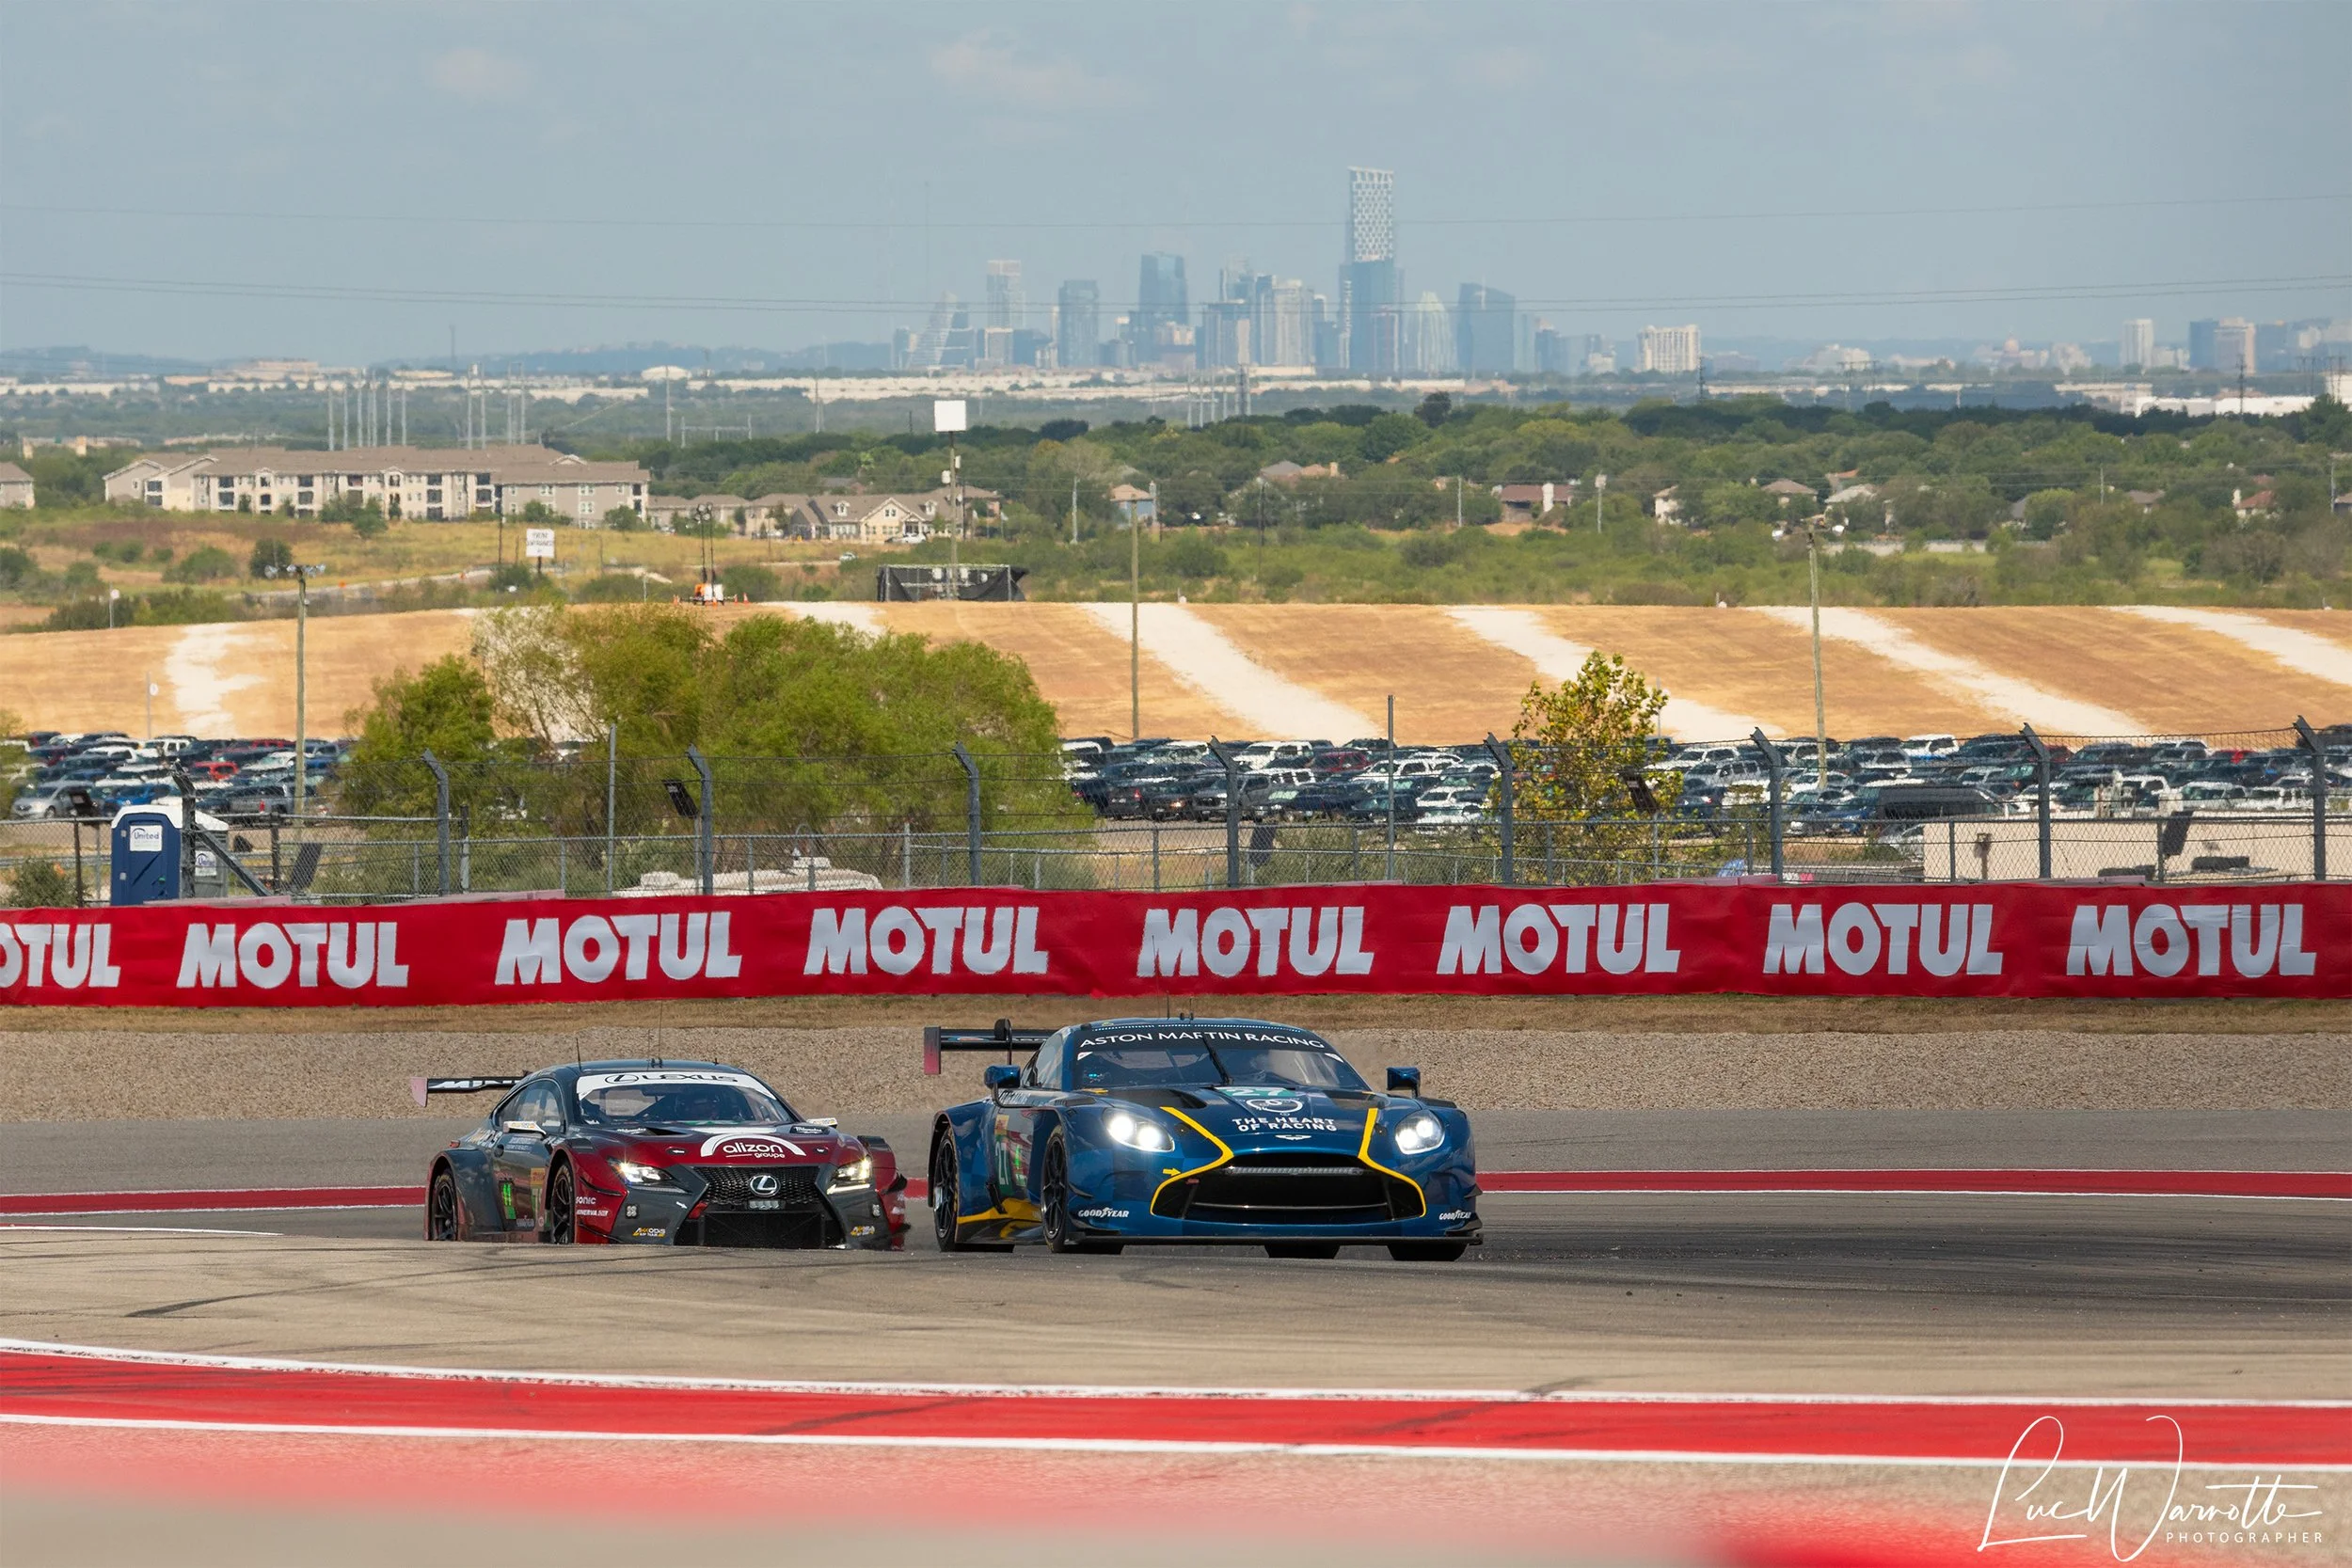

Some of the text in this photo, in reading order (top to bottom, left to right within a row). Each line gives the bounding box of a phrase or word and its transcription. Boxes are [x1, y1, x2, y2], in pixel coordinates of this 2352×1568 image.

[176, 922, 408, 989] MOTUL
[495, 911, 741, 985] MOTUL
[803, 907, 1048, 975] MOTUL
[1136, 906, 1374, 977] MOTUL
[1437, 903, 1681, 974] MOTUL
[1762, 902, 2003, 976] MOTUL
[2066, 904, 2316, 978] MOTUL
[1080, 1031, 1325, 1049] ASTON MARTIN RACING
[642, 1074, 739, 1083] LEXUS
[1225, 1087, 1285, 1097] 27
[1232, 1117, 1335, 1126] THE HEART
[1237, 1123, 1338, 1132] OF RACING
[723, 1142, 784, 1153] alizon
[1077, 1207, 1130, 1218] GOODYEAR
